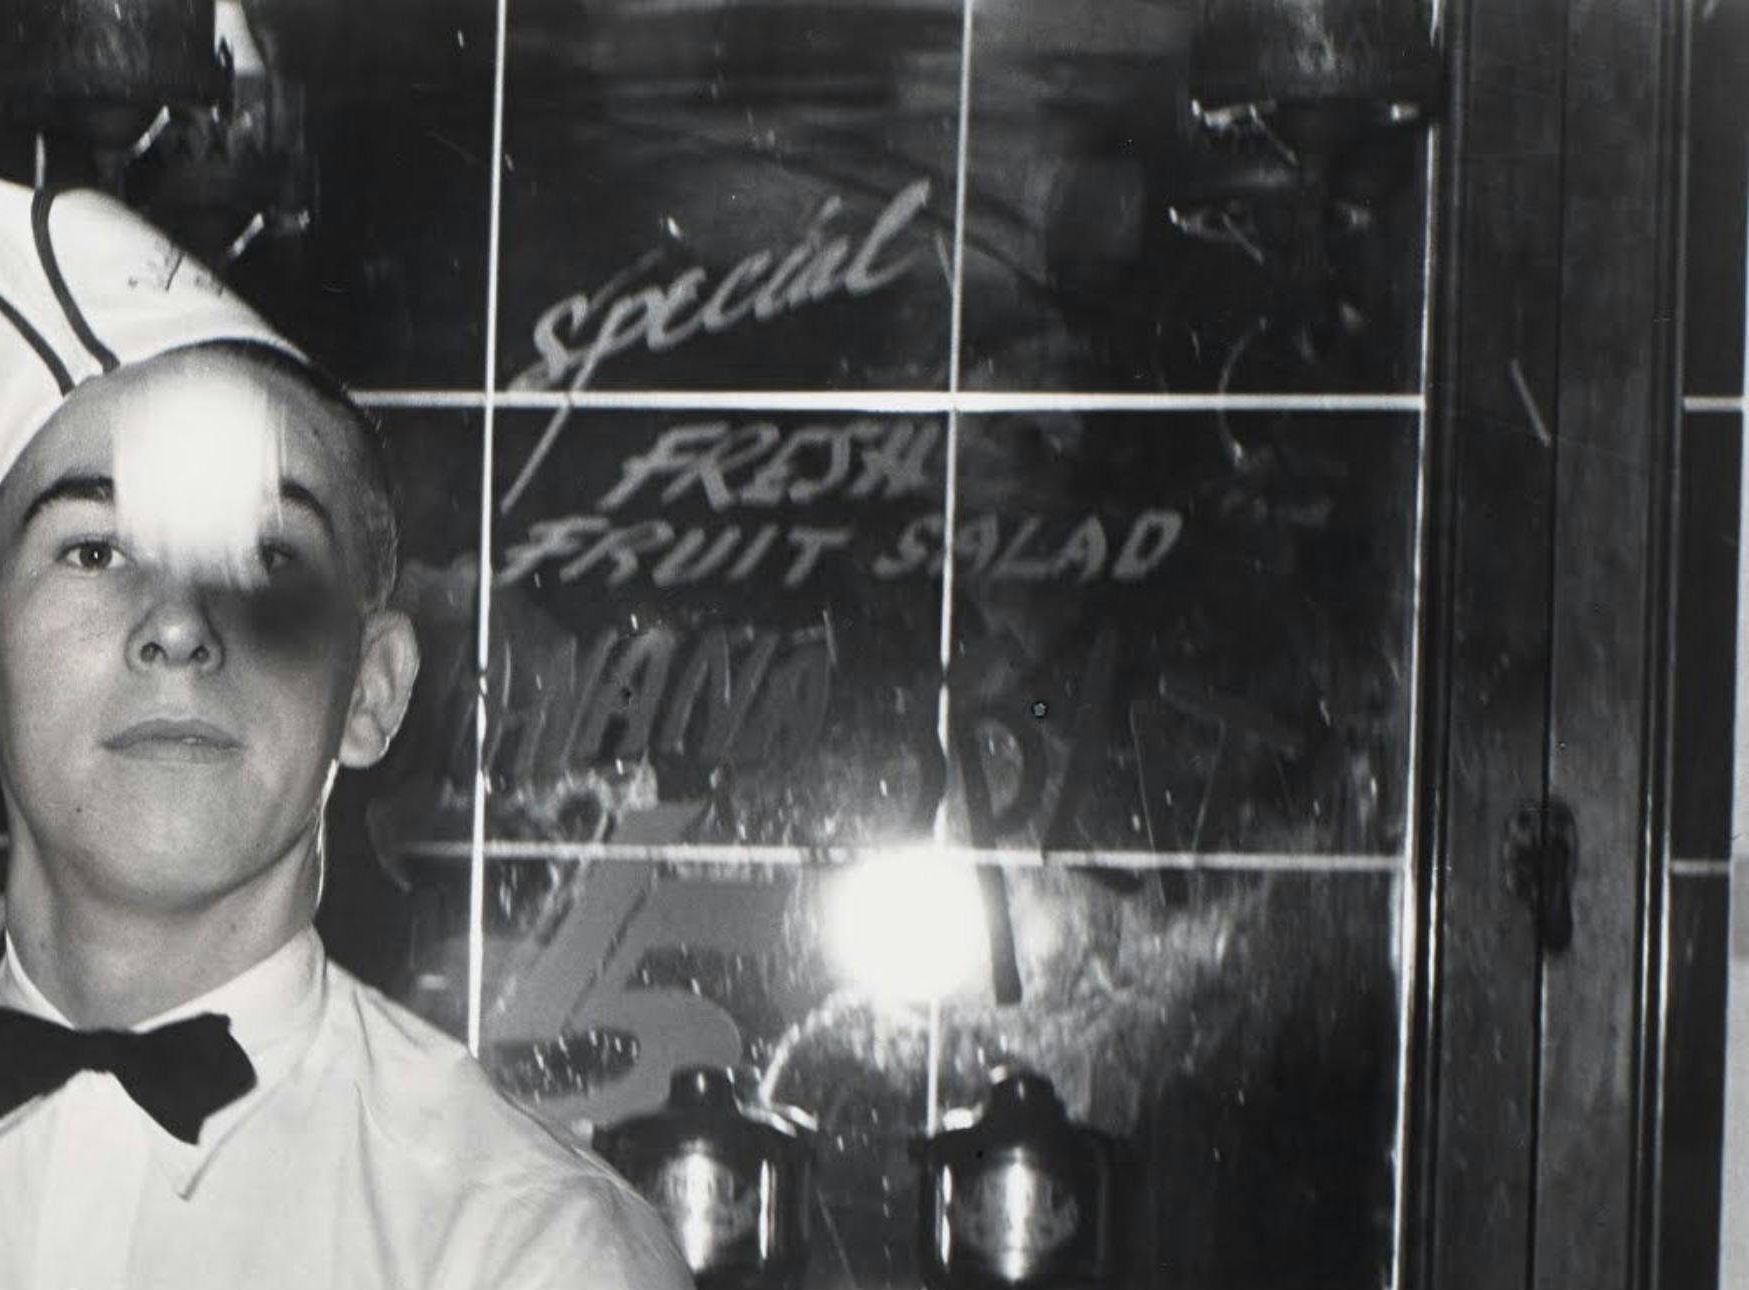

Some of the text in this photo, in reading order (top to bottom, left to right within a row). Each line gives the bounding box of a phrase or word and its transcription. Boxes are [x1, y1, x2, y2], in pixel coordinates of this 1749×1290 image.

[501, 177, 932, 515] Special
[598, 420, 942, 513] FRESH
[496, 509, 1182, 588] FRUIT SALAD
